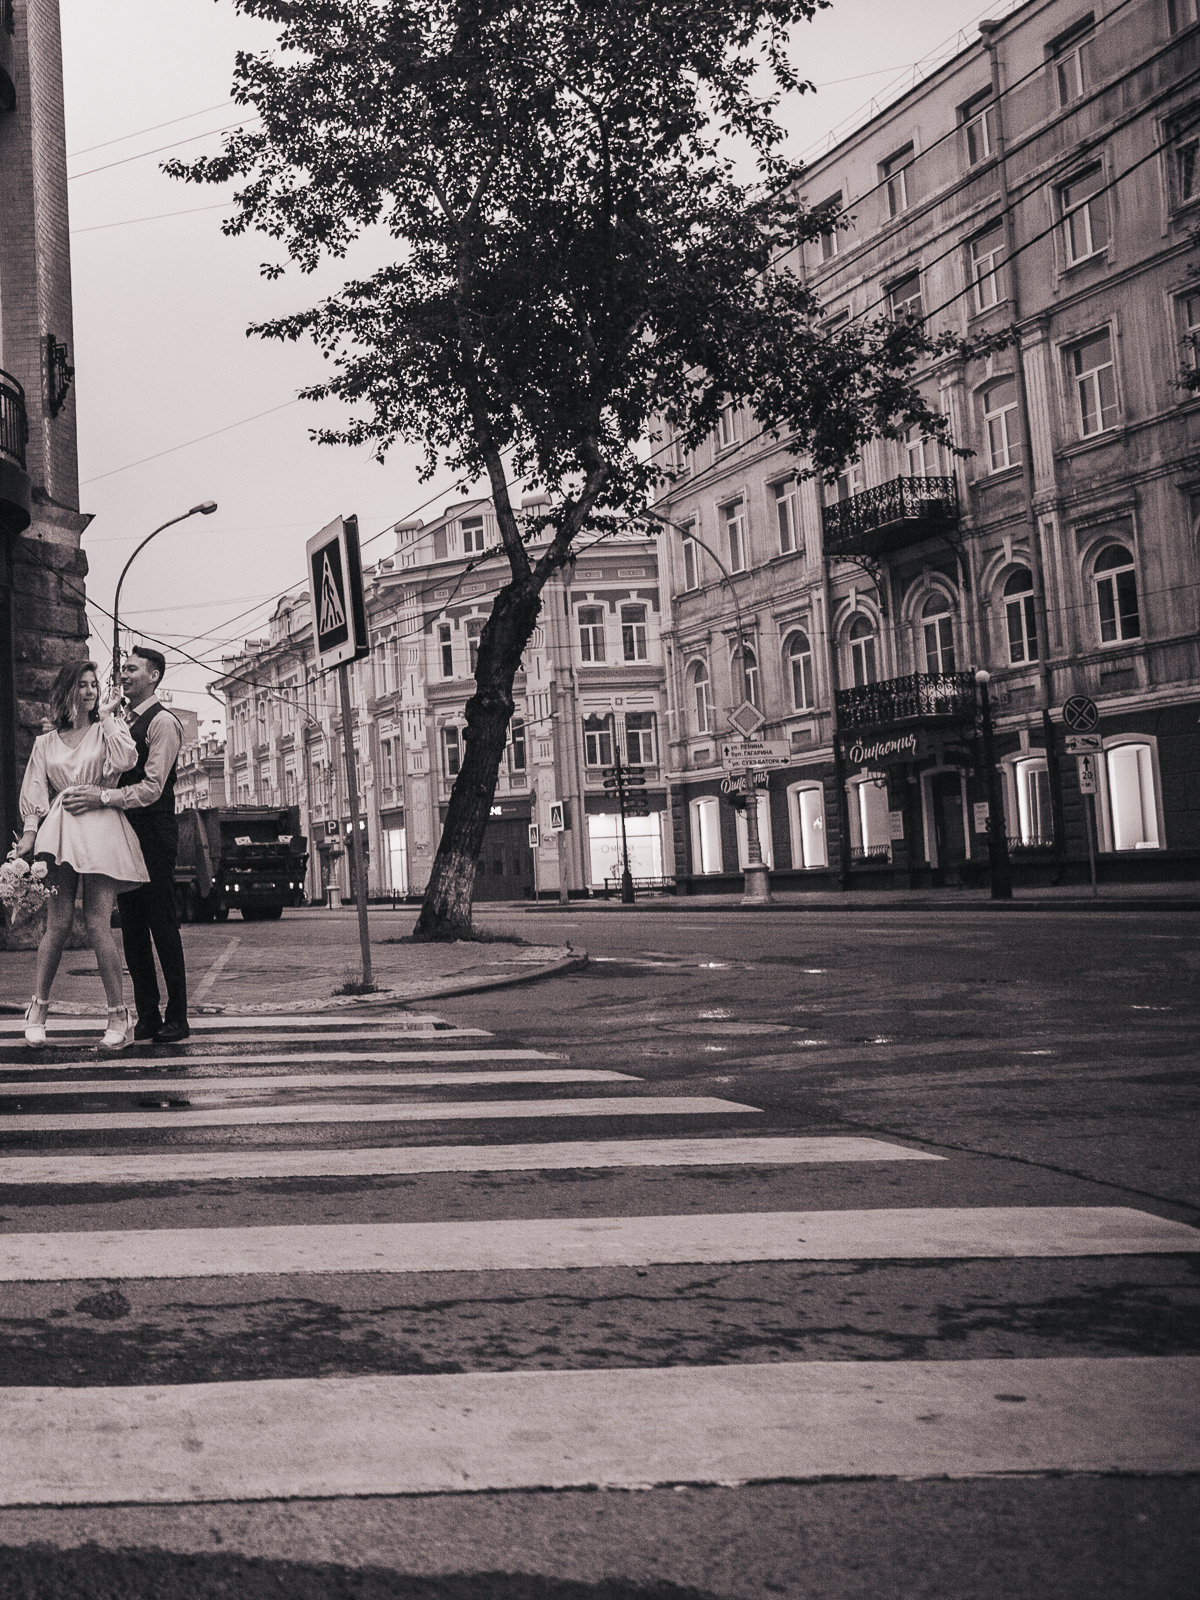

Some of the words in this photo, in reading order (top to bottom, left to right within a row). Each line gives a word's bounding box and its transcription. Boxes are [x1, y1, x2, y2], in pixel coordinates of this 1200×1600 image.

[741, 758, 780, 766] СУХЭ-БАТОРА
[1082, 771, 1093, 780] 20
[328, 821, 336, 833] P
